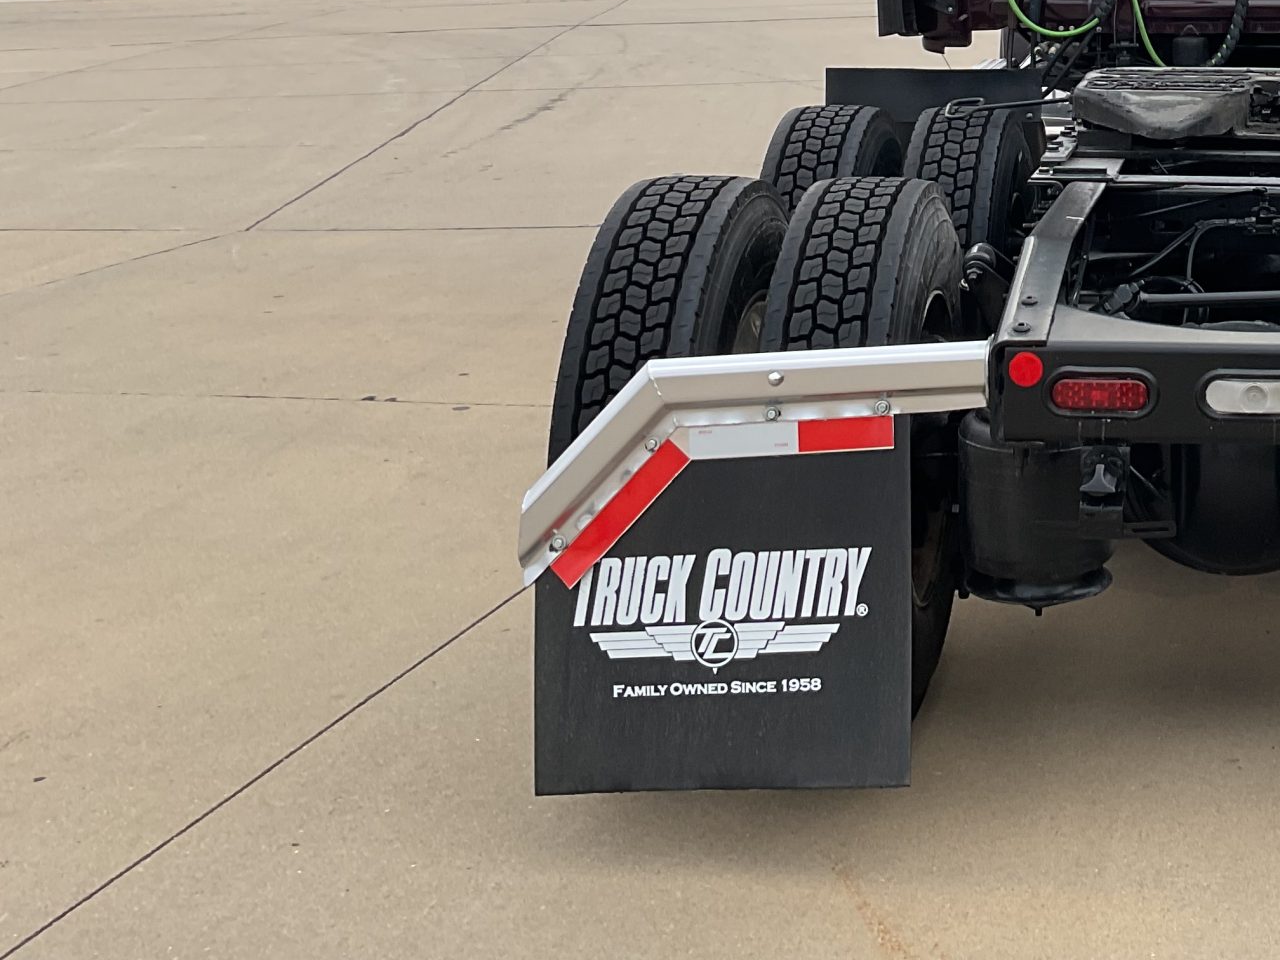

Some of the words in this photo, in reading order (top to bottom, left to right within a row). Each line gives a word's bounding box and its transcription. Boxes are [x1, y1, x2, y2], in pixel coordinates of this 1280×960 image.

[612, 684, 668, 698] FAMILY
[670, 682, 728, 696] OWNED
[730, 680, 777, 694] SINCE
[781, 678, 822, 692] 1958
